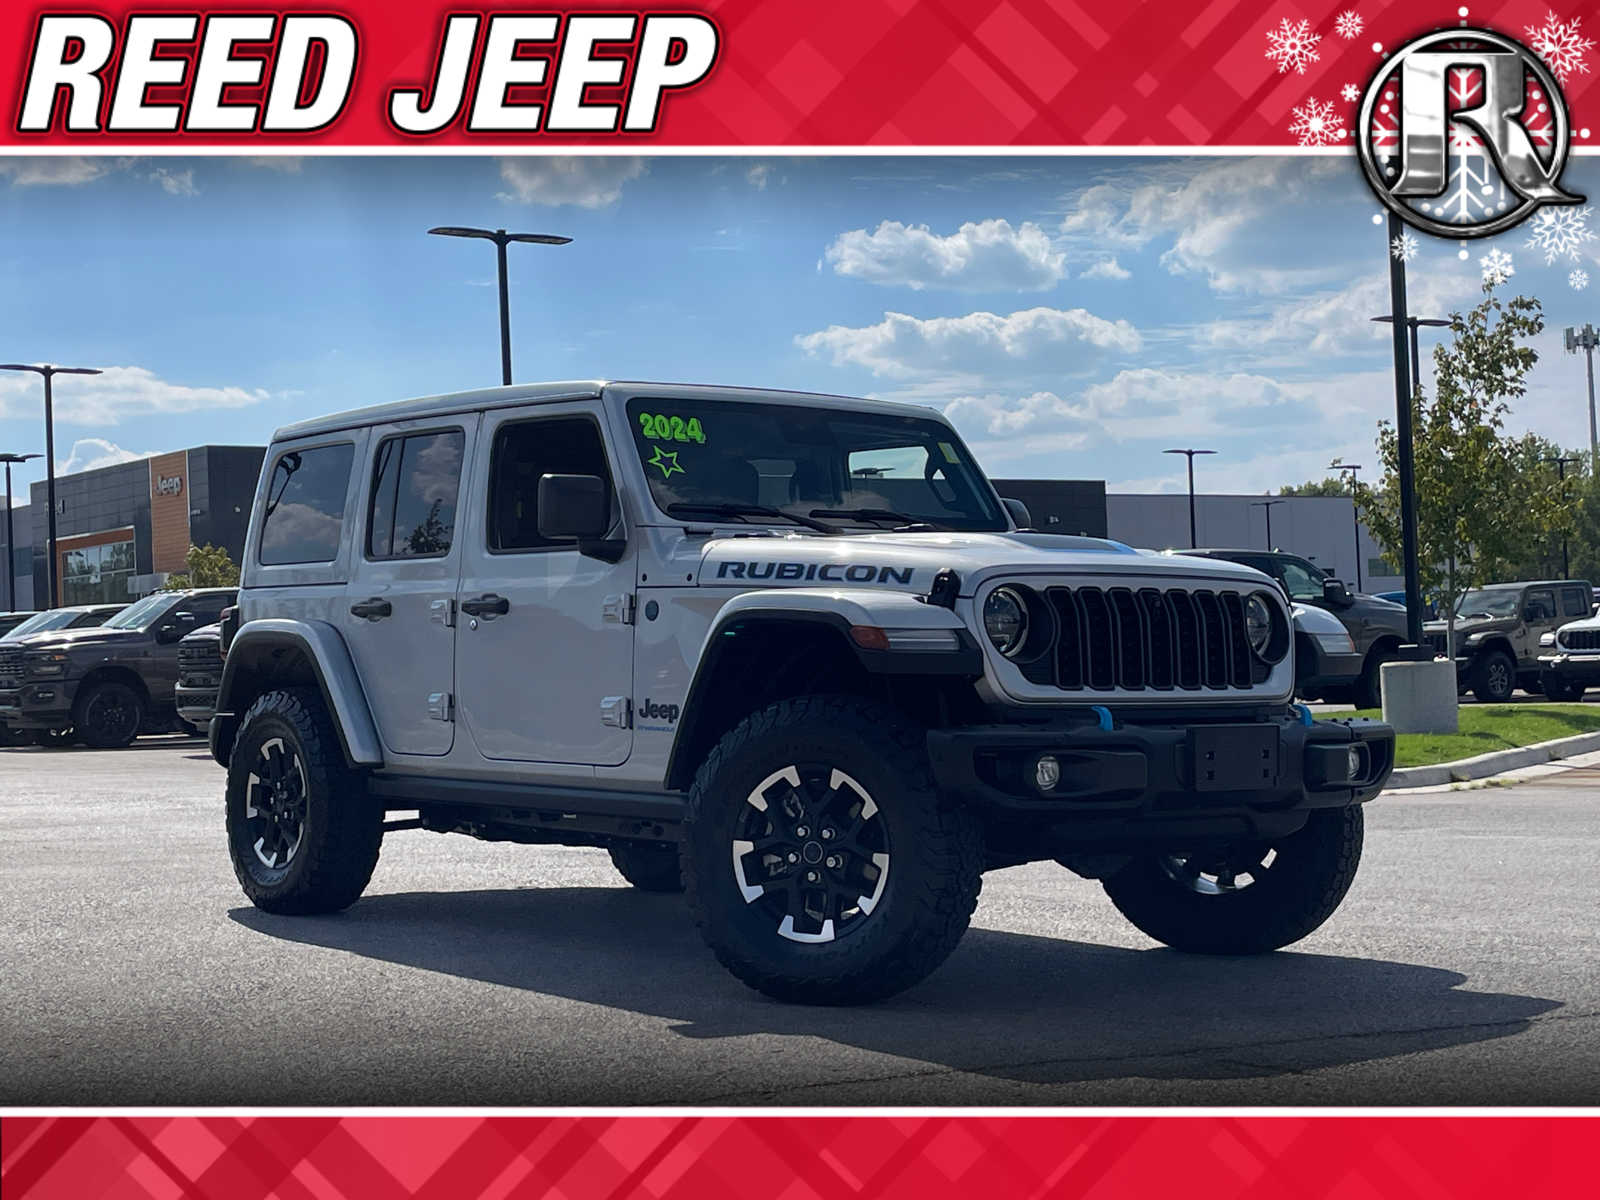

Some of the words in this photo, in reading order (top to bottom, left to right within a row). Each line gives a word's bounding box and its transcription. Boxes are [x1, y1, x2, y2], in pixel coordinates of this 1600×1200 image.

[640, 413, 706, 444] 2024
[156, 474, 182, 496] Jeep
[716, 561, 915, 585] RUBICON
[639, 698, 679, 724] Jeep
